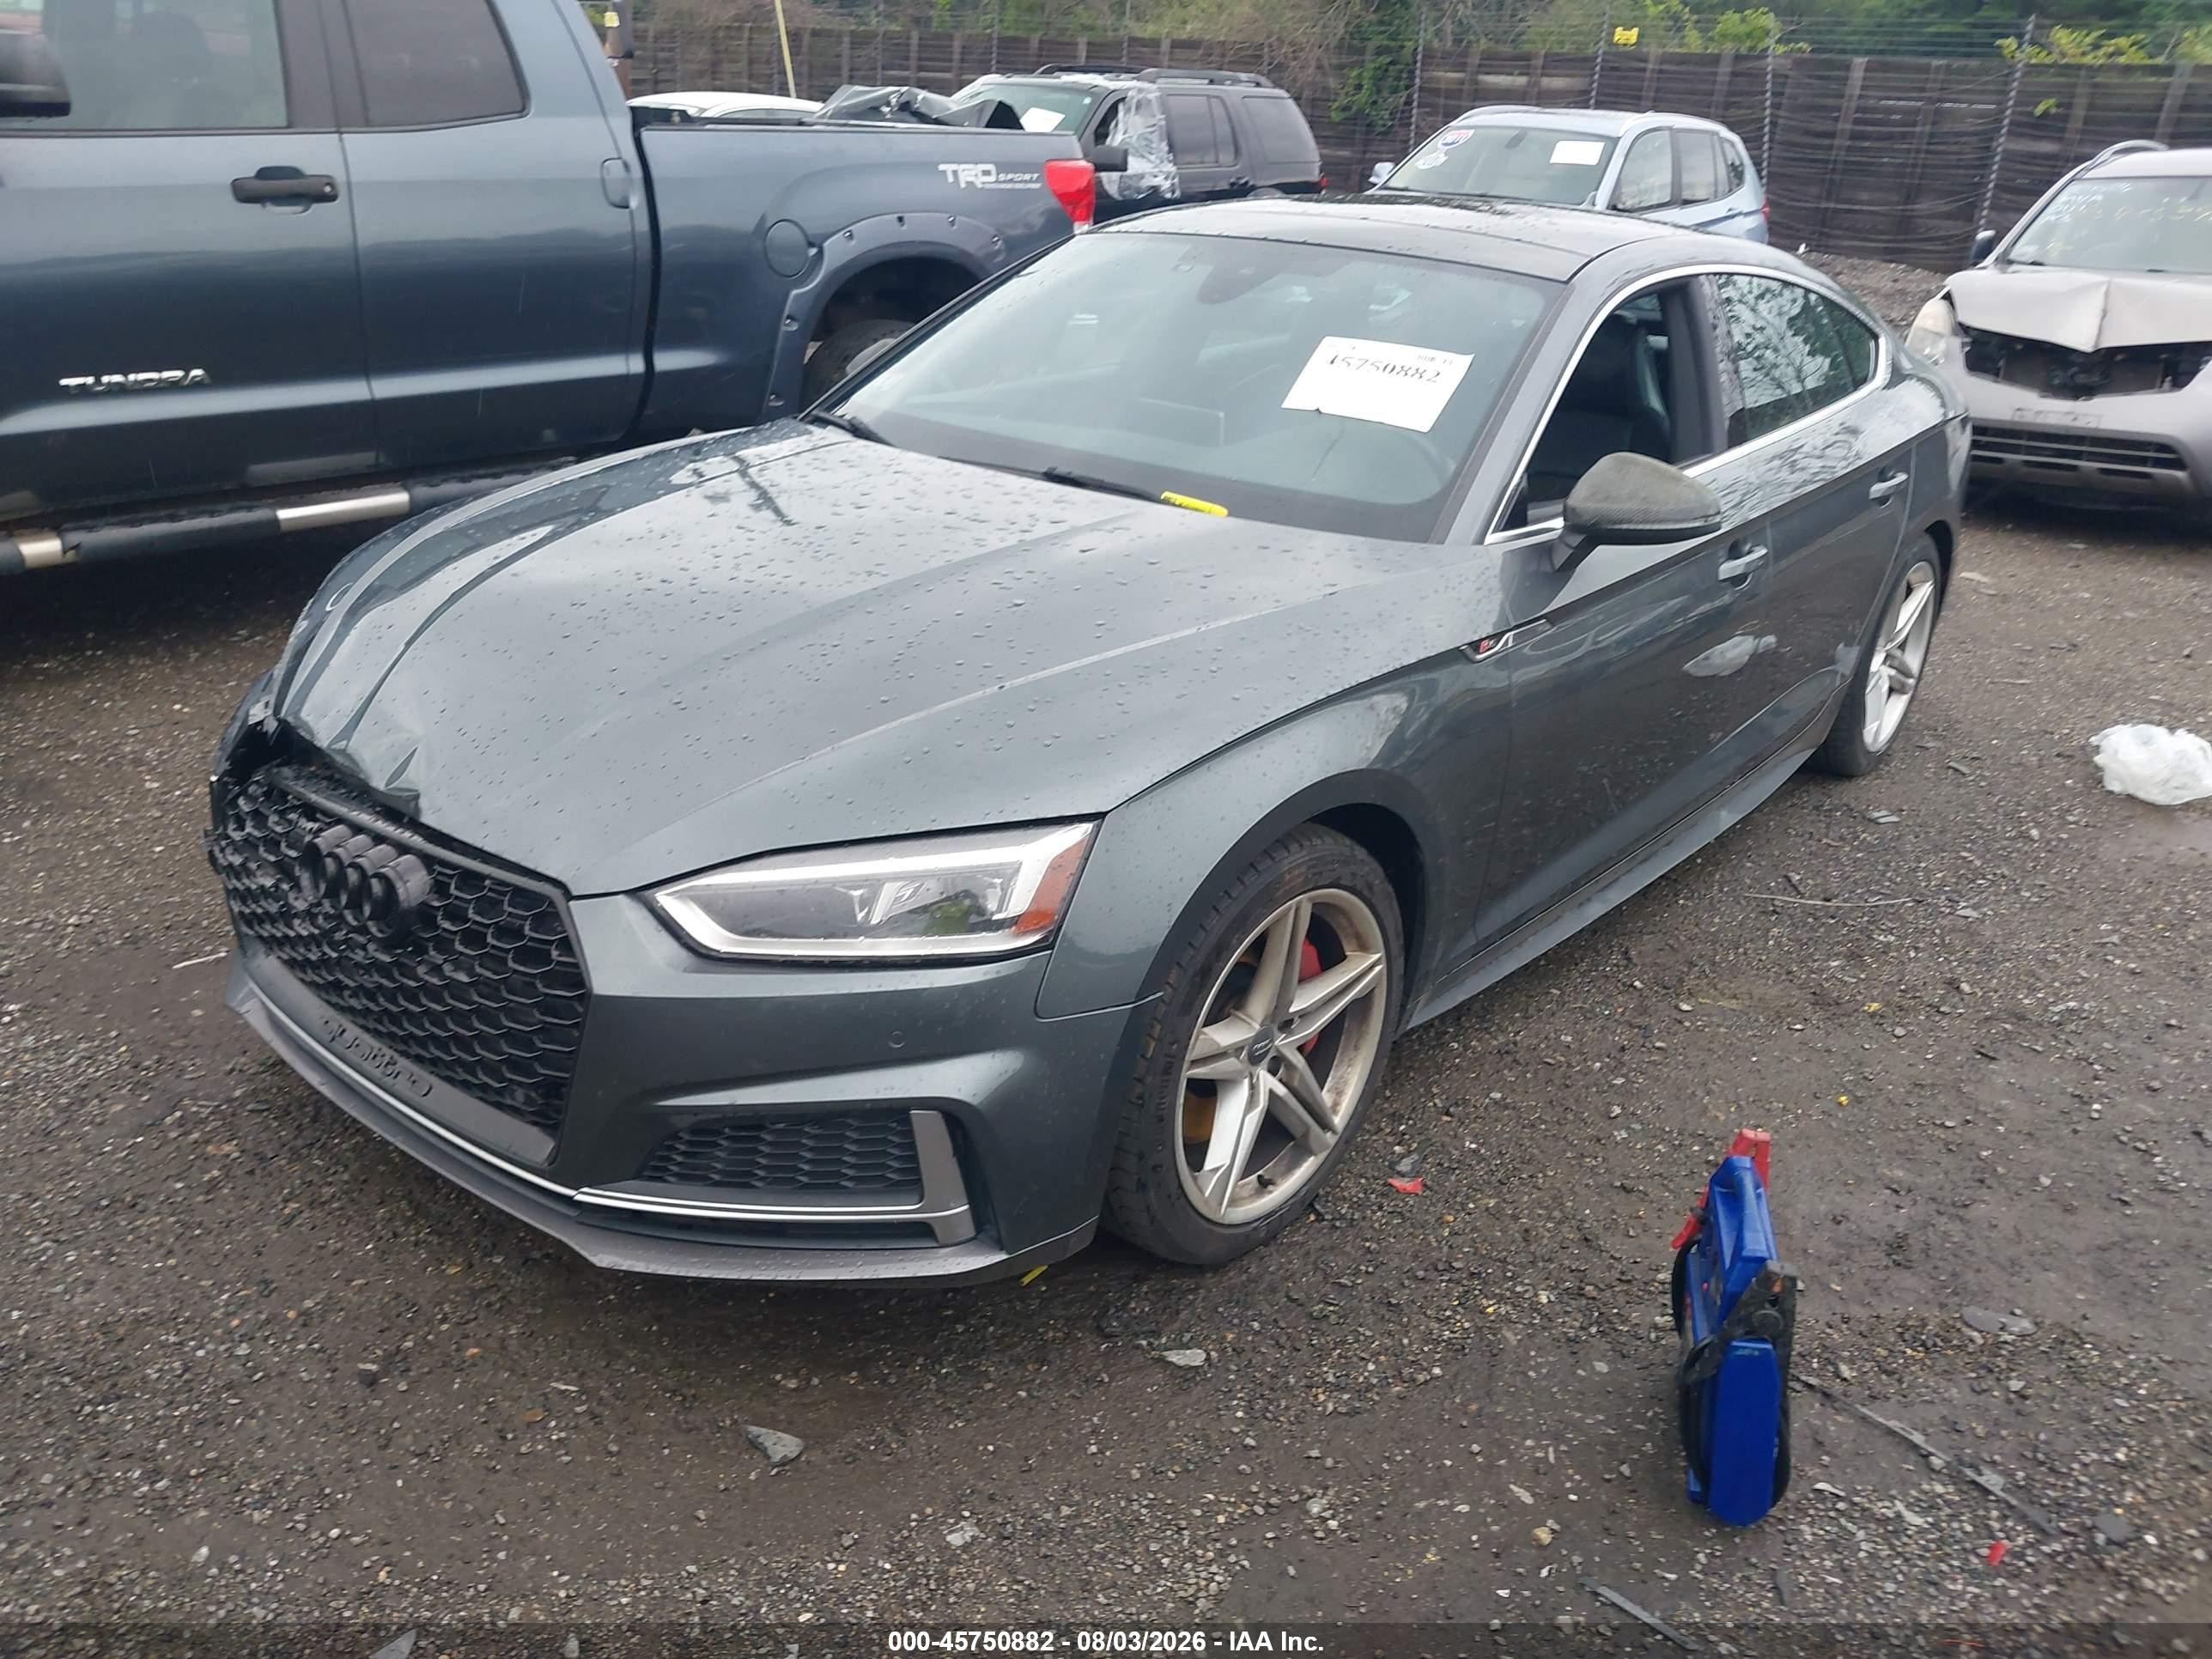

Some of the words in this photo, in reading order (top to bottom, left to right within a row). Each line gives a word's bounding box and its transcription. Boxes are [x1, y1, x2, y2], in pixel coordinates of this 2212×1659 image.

[937, 163, 996, 189] TRD
[998, 173, 1041, 182] SPORT
[58, 368, 211, 395] TUNDRA
